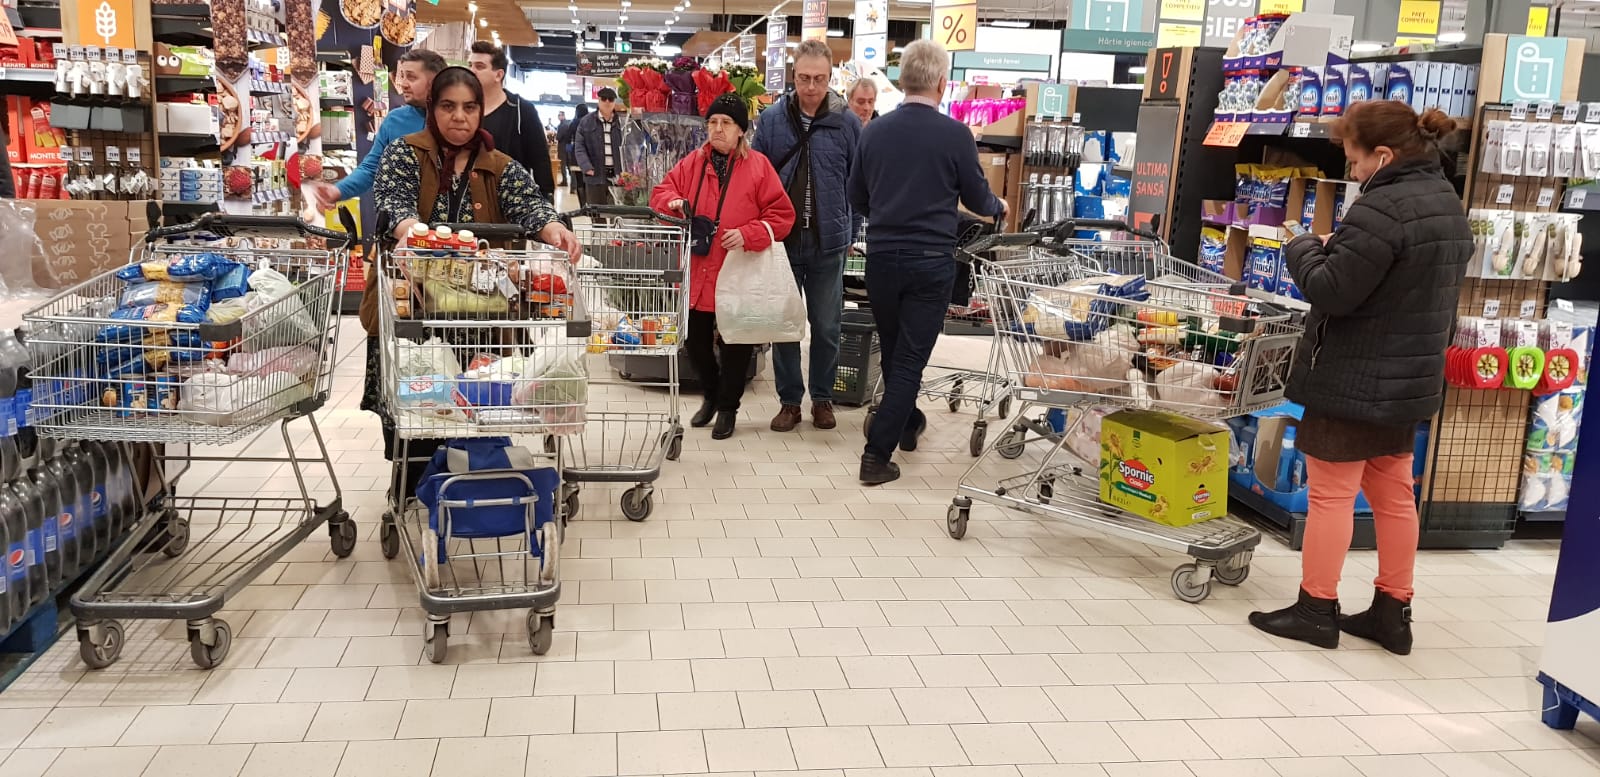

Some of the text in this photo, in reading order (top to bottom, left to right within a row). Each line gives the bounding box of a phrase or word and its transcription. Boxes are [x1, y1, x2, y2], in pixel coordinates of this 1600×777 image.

[30, 151, 56, 160] MONTE
[1136, 162, 1169, 177] ULTIMA
[1253, 256, 1274, 275] finish
[1118, 461, 1155, 485] Spornic
